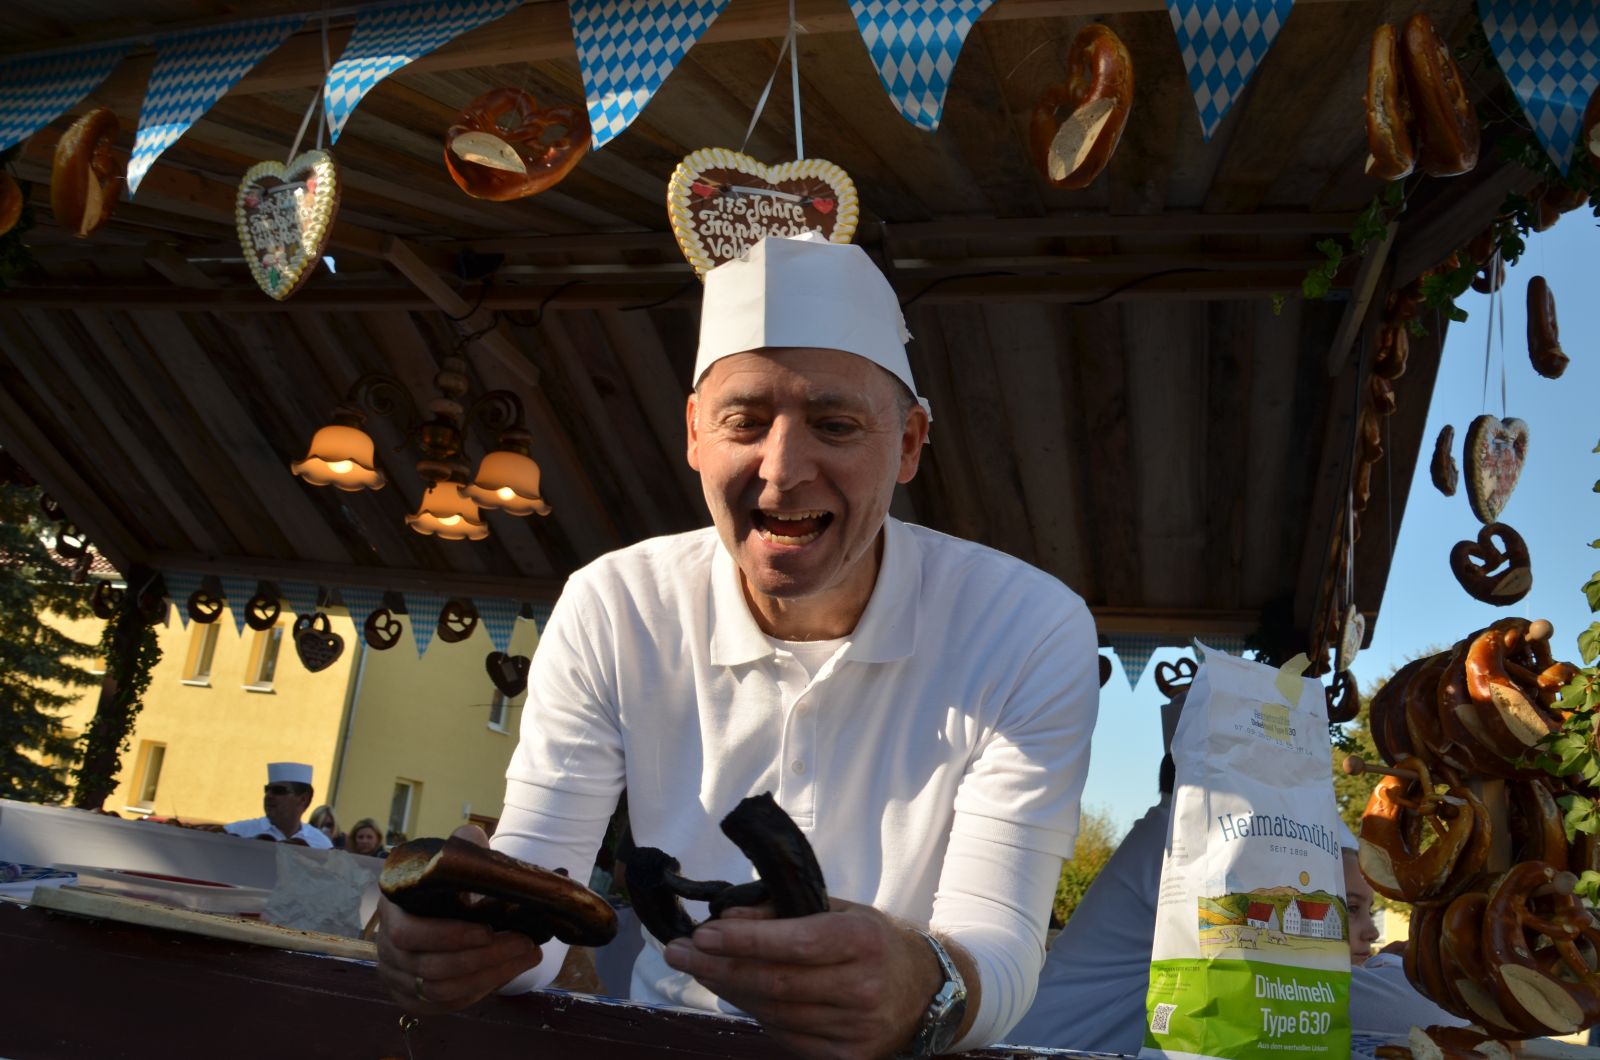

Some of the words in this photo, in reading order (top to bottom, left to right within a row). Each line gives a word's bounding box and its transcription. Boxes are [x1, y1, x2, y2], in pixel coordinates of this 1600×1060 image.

[713, 197, 747, 215] 175
[746, 194, 806, 223] Jahre
[1218, 811, 1338, 860] Heimatsmühle
[1270, 845, 1287, 854] SEIT
[1255, 974, 1335, 1003] Dinkelmehl
[1260, 1007, 1296, 1038] Type
[1299, 1010, 1331, 1035] 630
